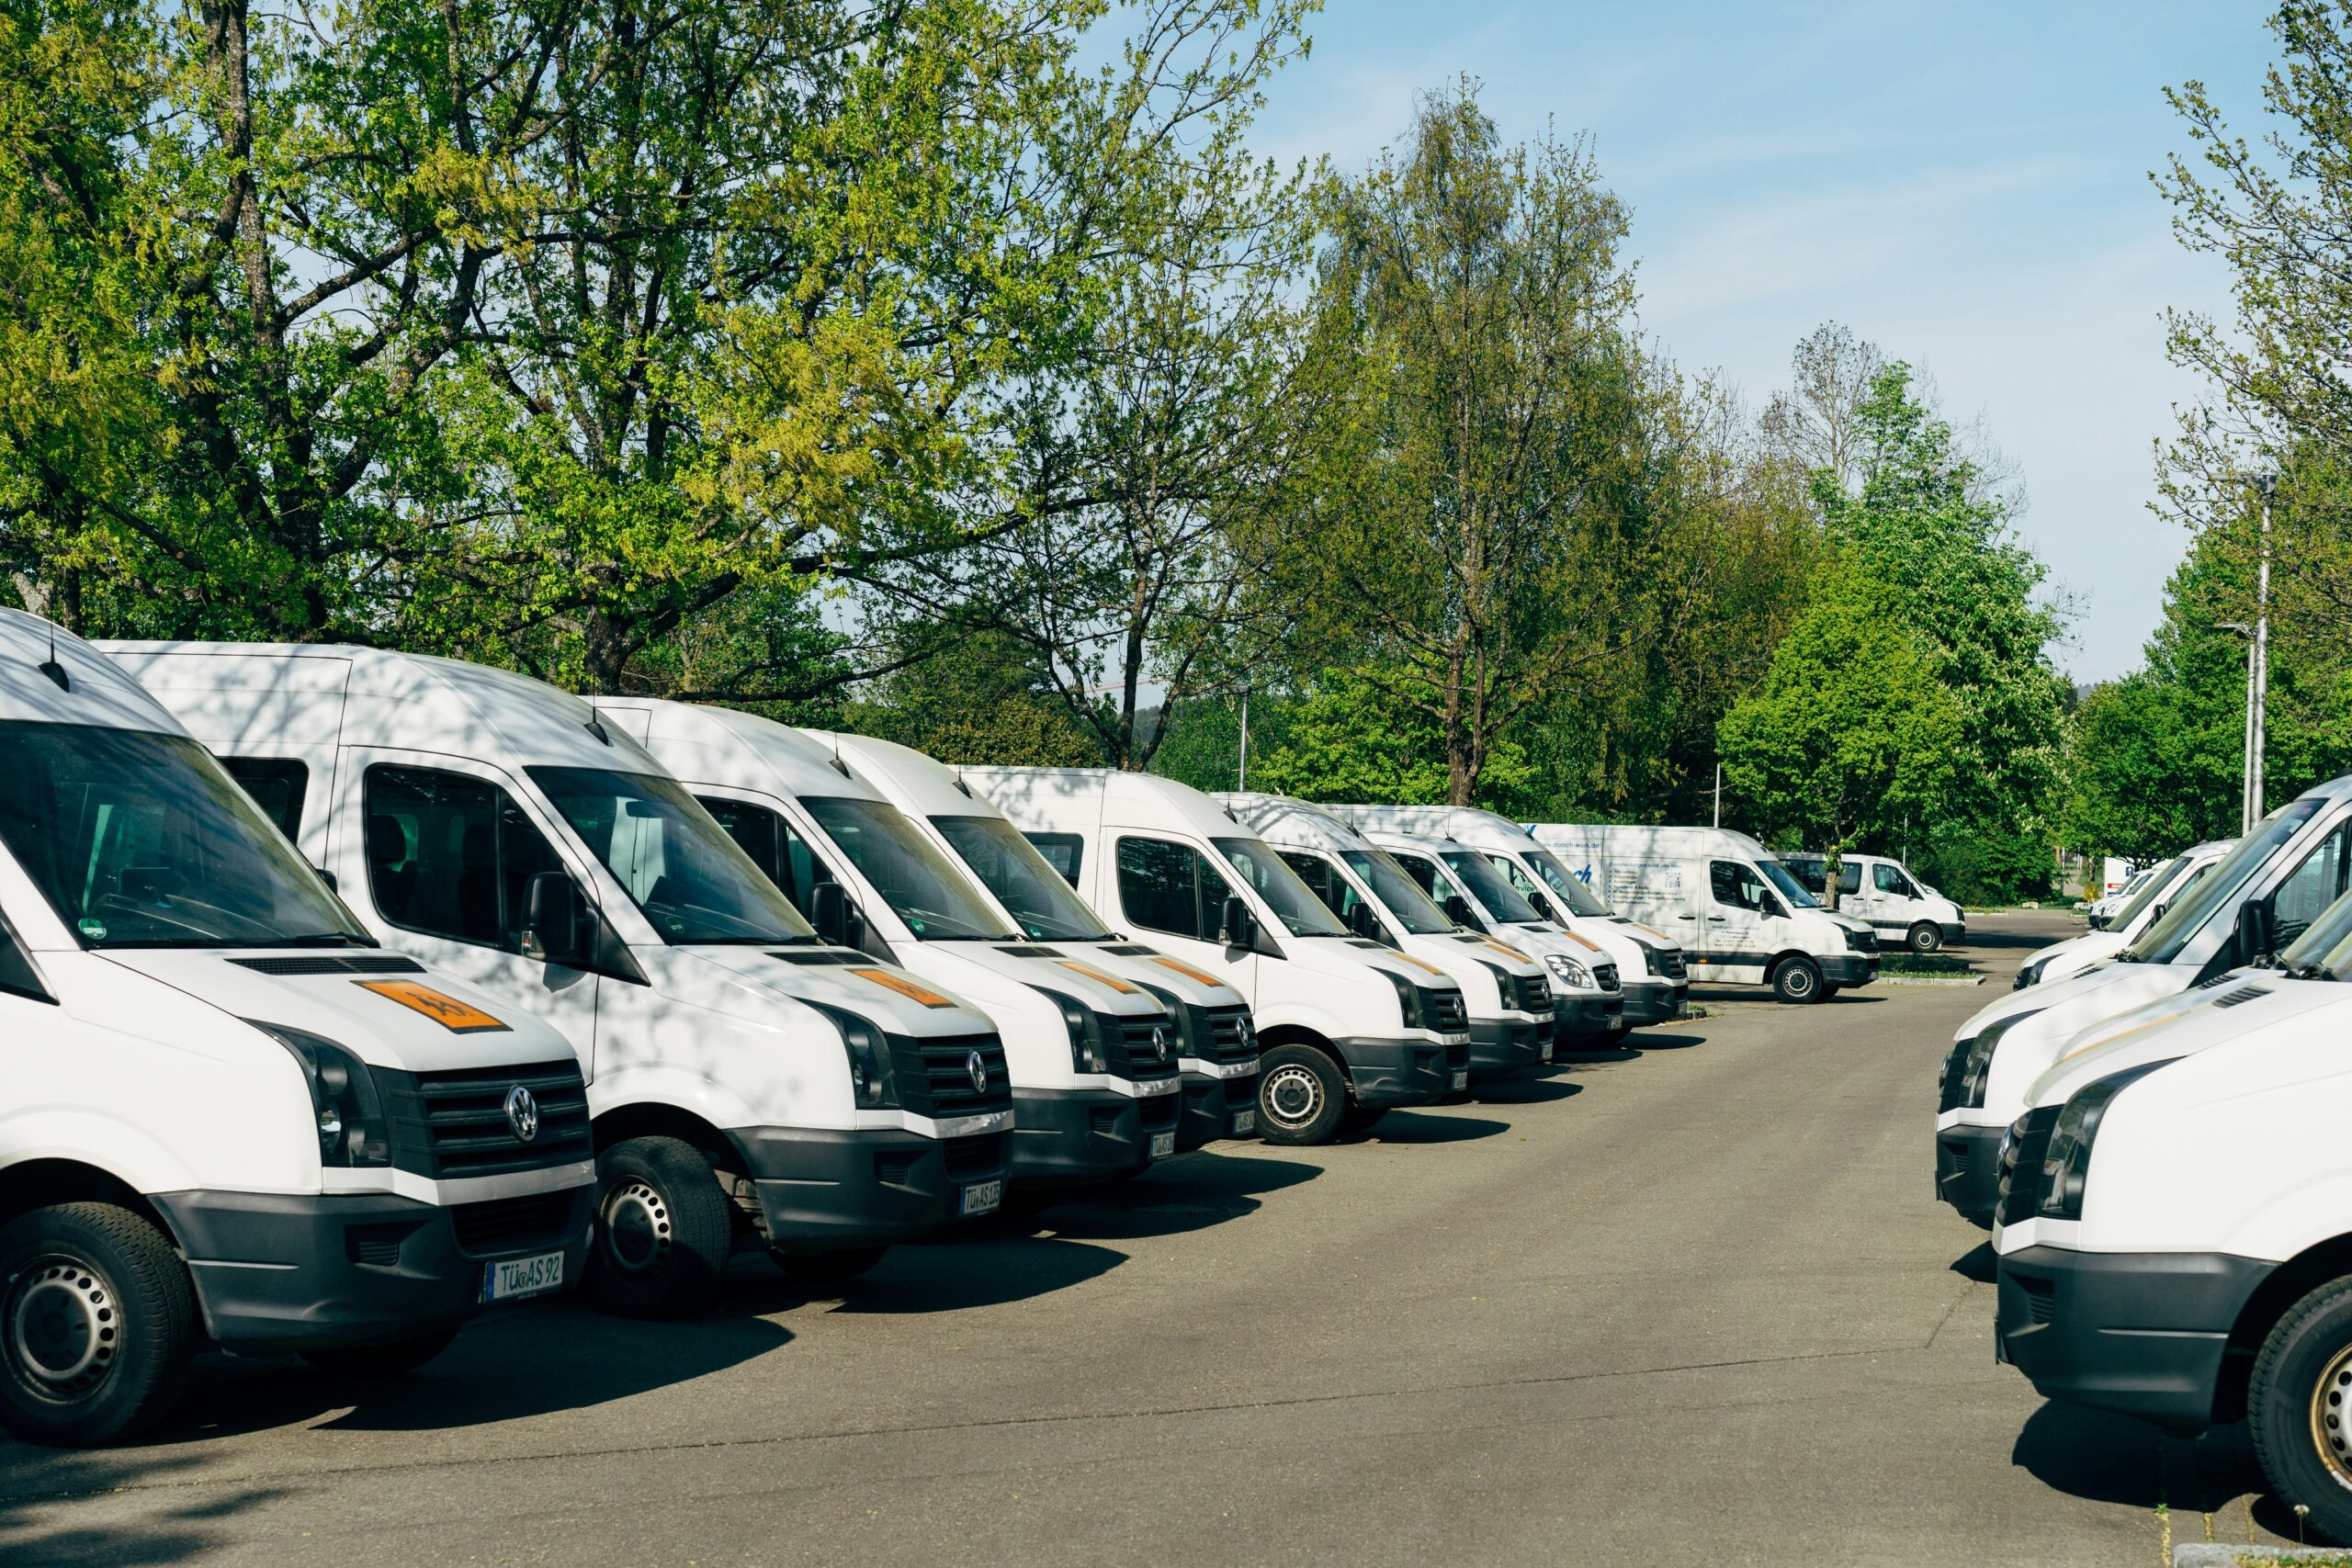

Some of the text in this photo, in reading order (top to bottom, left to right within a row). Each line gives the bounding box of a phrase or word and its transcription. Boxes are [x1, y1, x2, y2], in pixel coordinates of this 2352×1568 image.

[501, 1255, 560, 1291] TÜ AS 92
